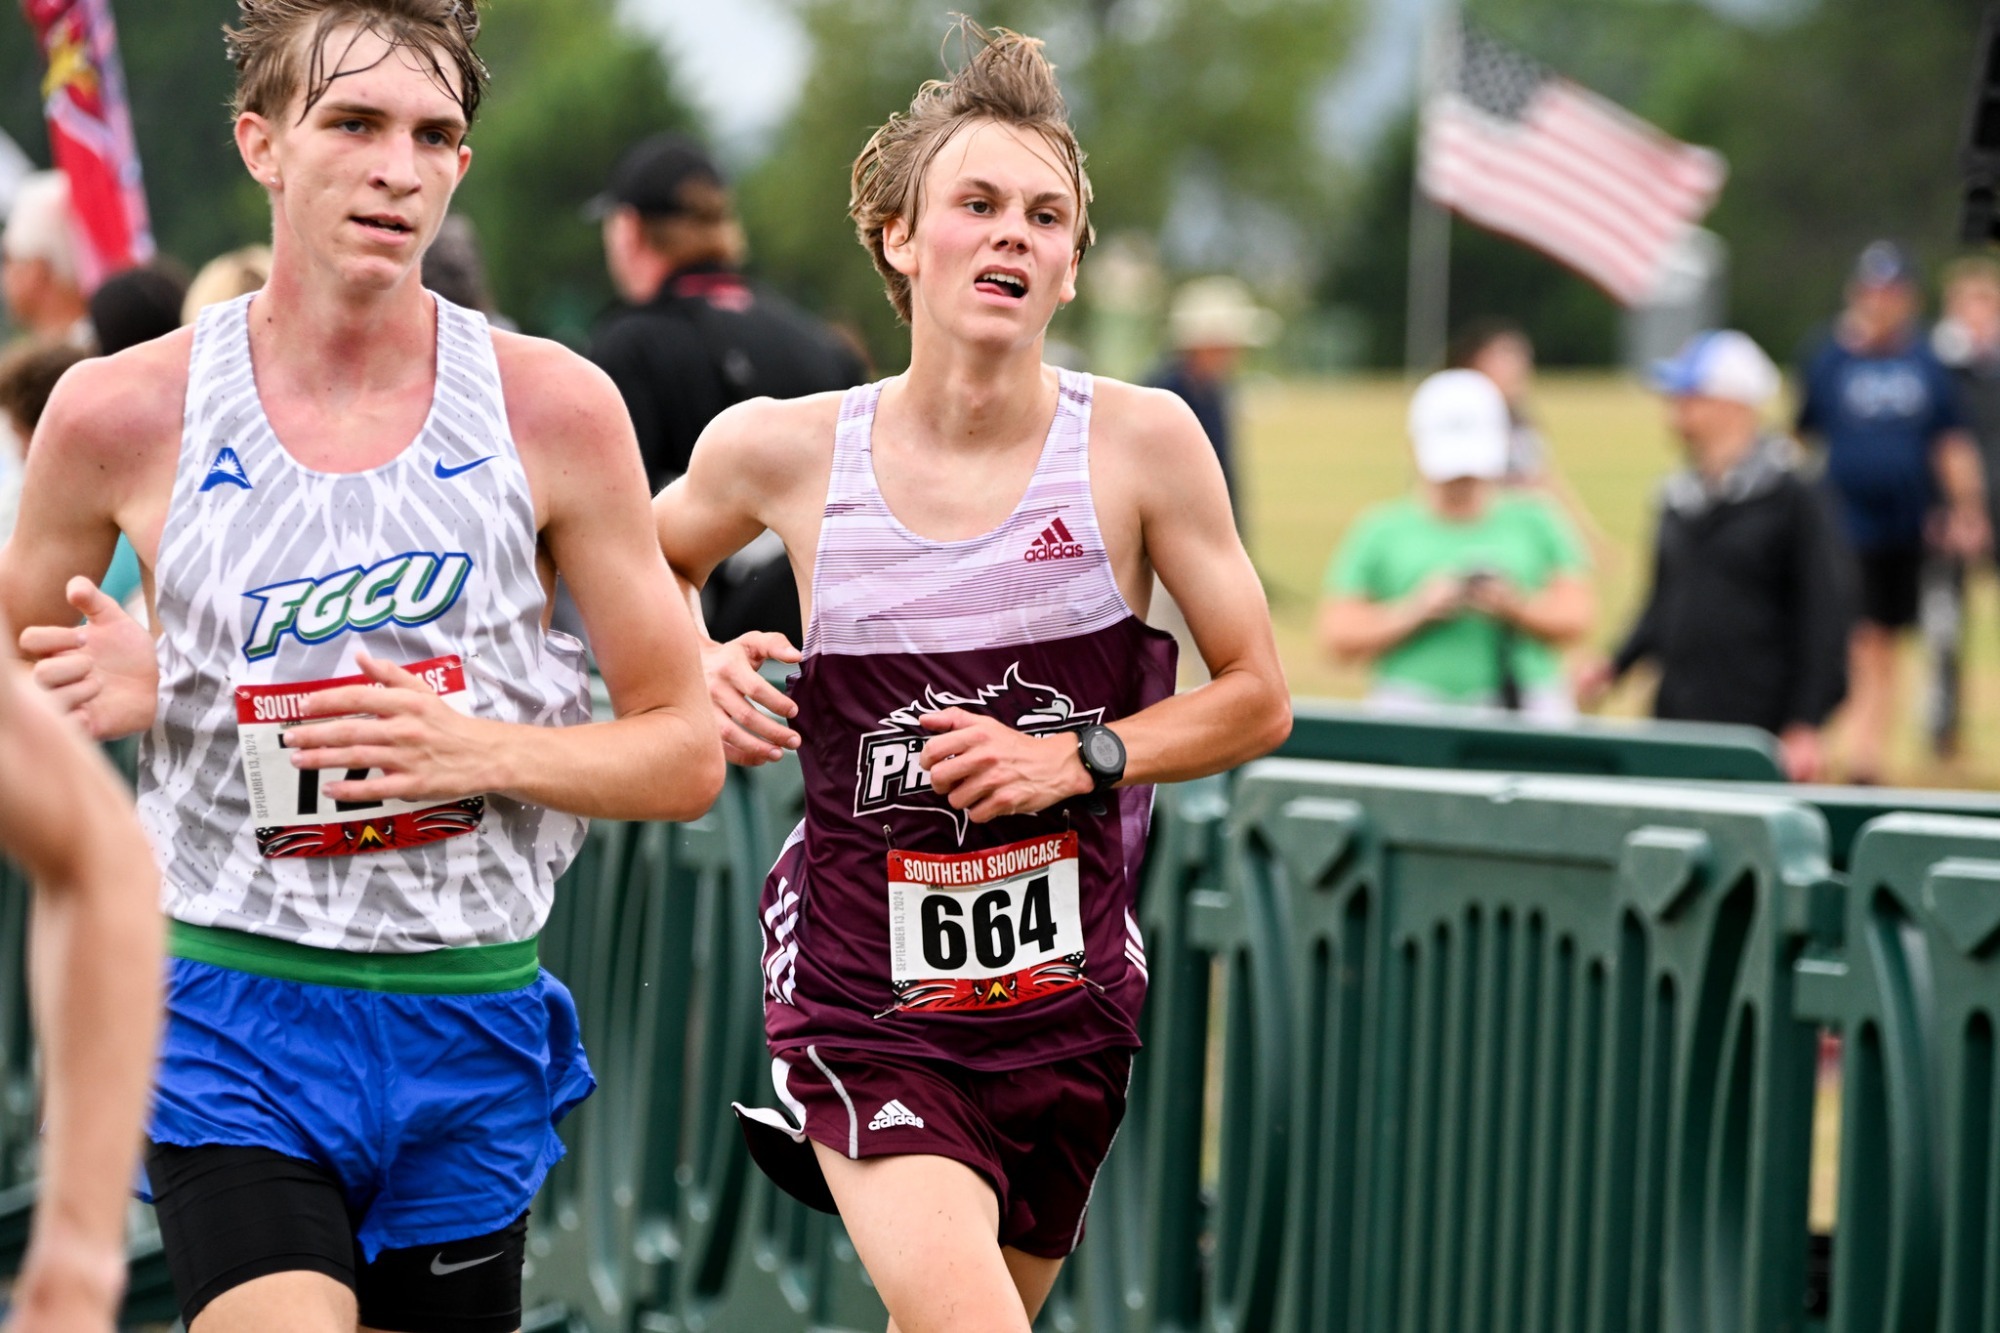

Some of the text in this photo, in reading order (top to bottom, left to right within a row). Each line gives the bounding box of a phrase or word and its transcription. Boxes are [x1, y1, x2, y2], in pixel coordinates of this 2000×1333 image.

[1024, 544, 1084, 562] adidas
[241, 552, 473, 663] FGCU
[244, 733, 269, 819] SEPTEMBER 13, 2024
[903, 839, 1062, 884] SOUTHERN SHOWCASE
[893, 891, 906, 971] SEPTEMBER 13, 2024
[920, 874, 1058, 971] 664
[868, 1114, 924, 1130] adidas
